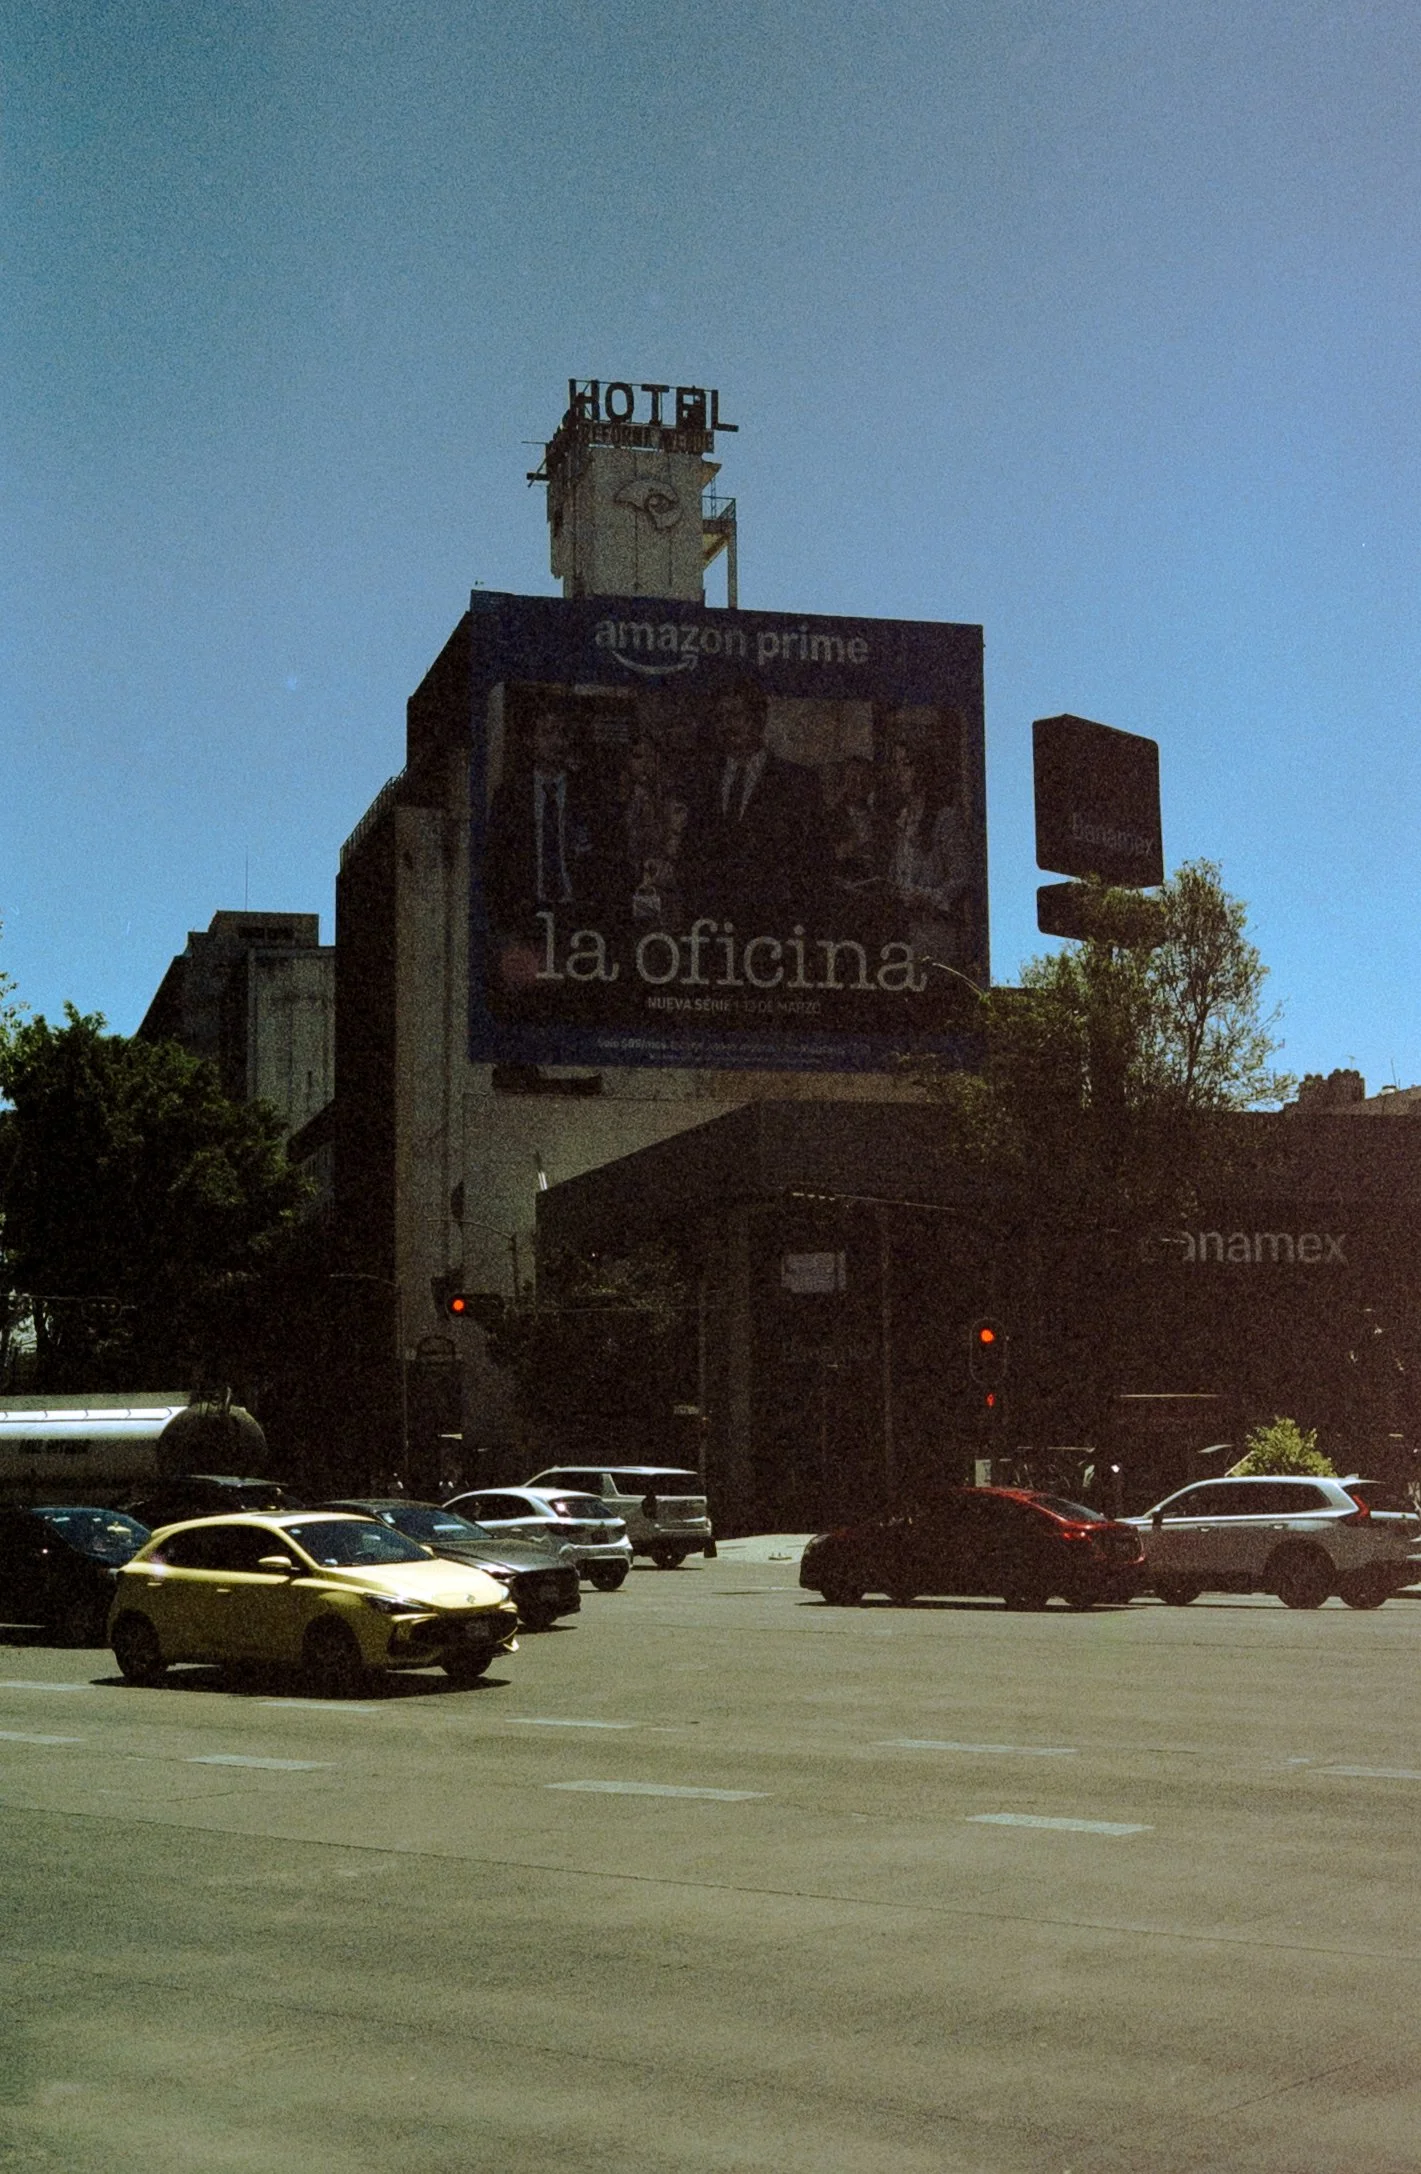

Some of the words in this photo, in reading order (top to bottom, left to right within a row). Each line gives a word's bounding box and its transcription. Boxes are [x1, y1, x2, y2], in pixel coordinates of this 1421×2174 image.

[569, 378, 738, 432] HOTEL
[594, 619, 746, 657] amazon
[756, 623, 868, 665] prime
[535, 912, 620, 982] la
[635, 918, 927, 993] oficina
[647, 996, 692, 1011] NUEVA
